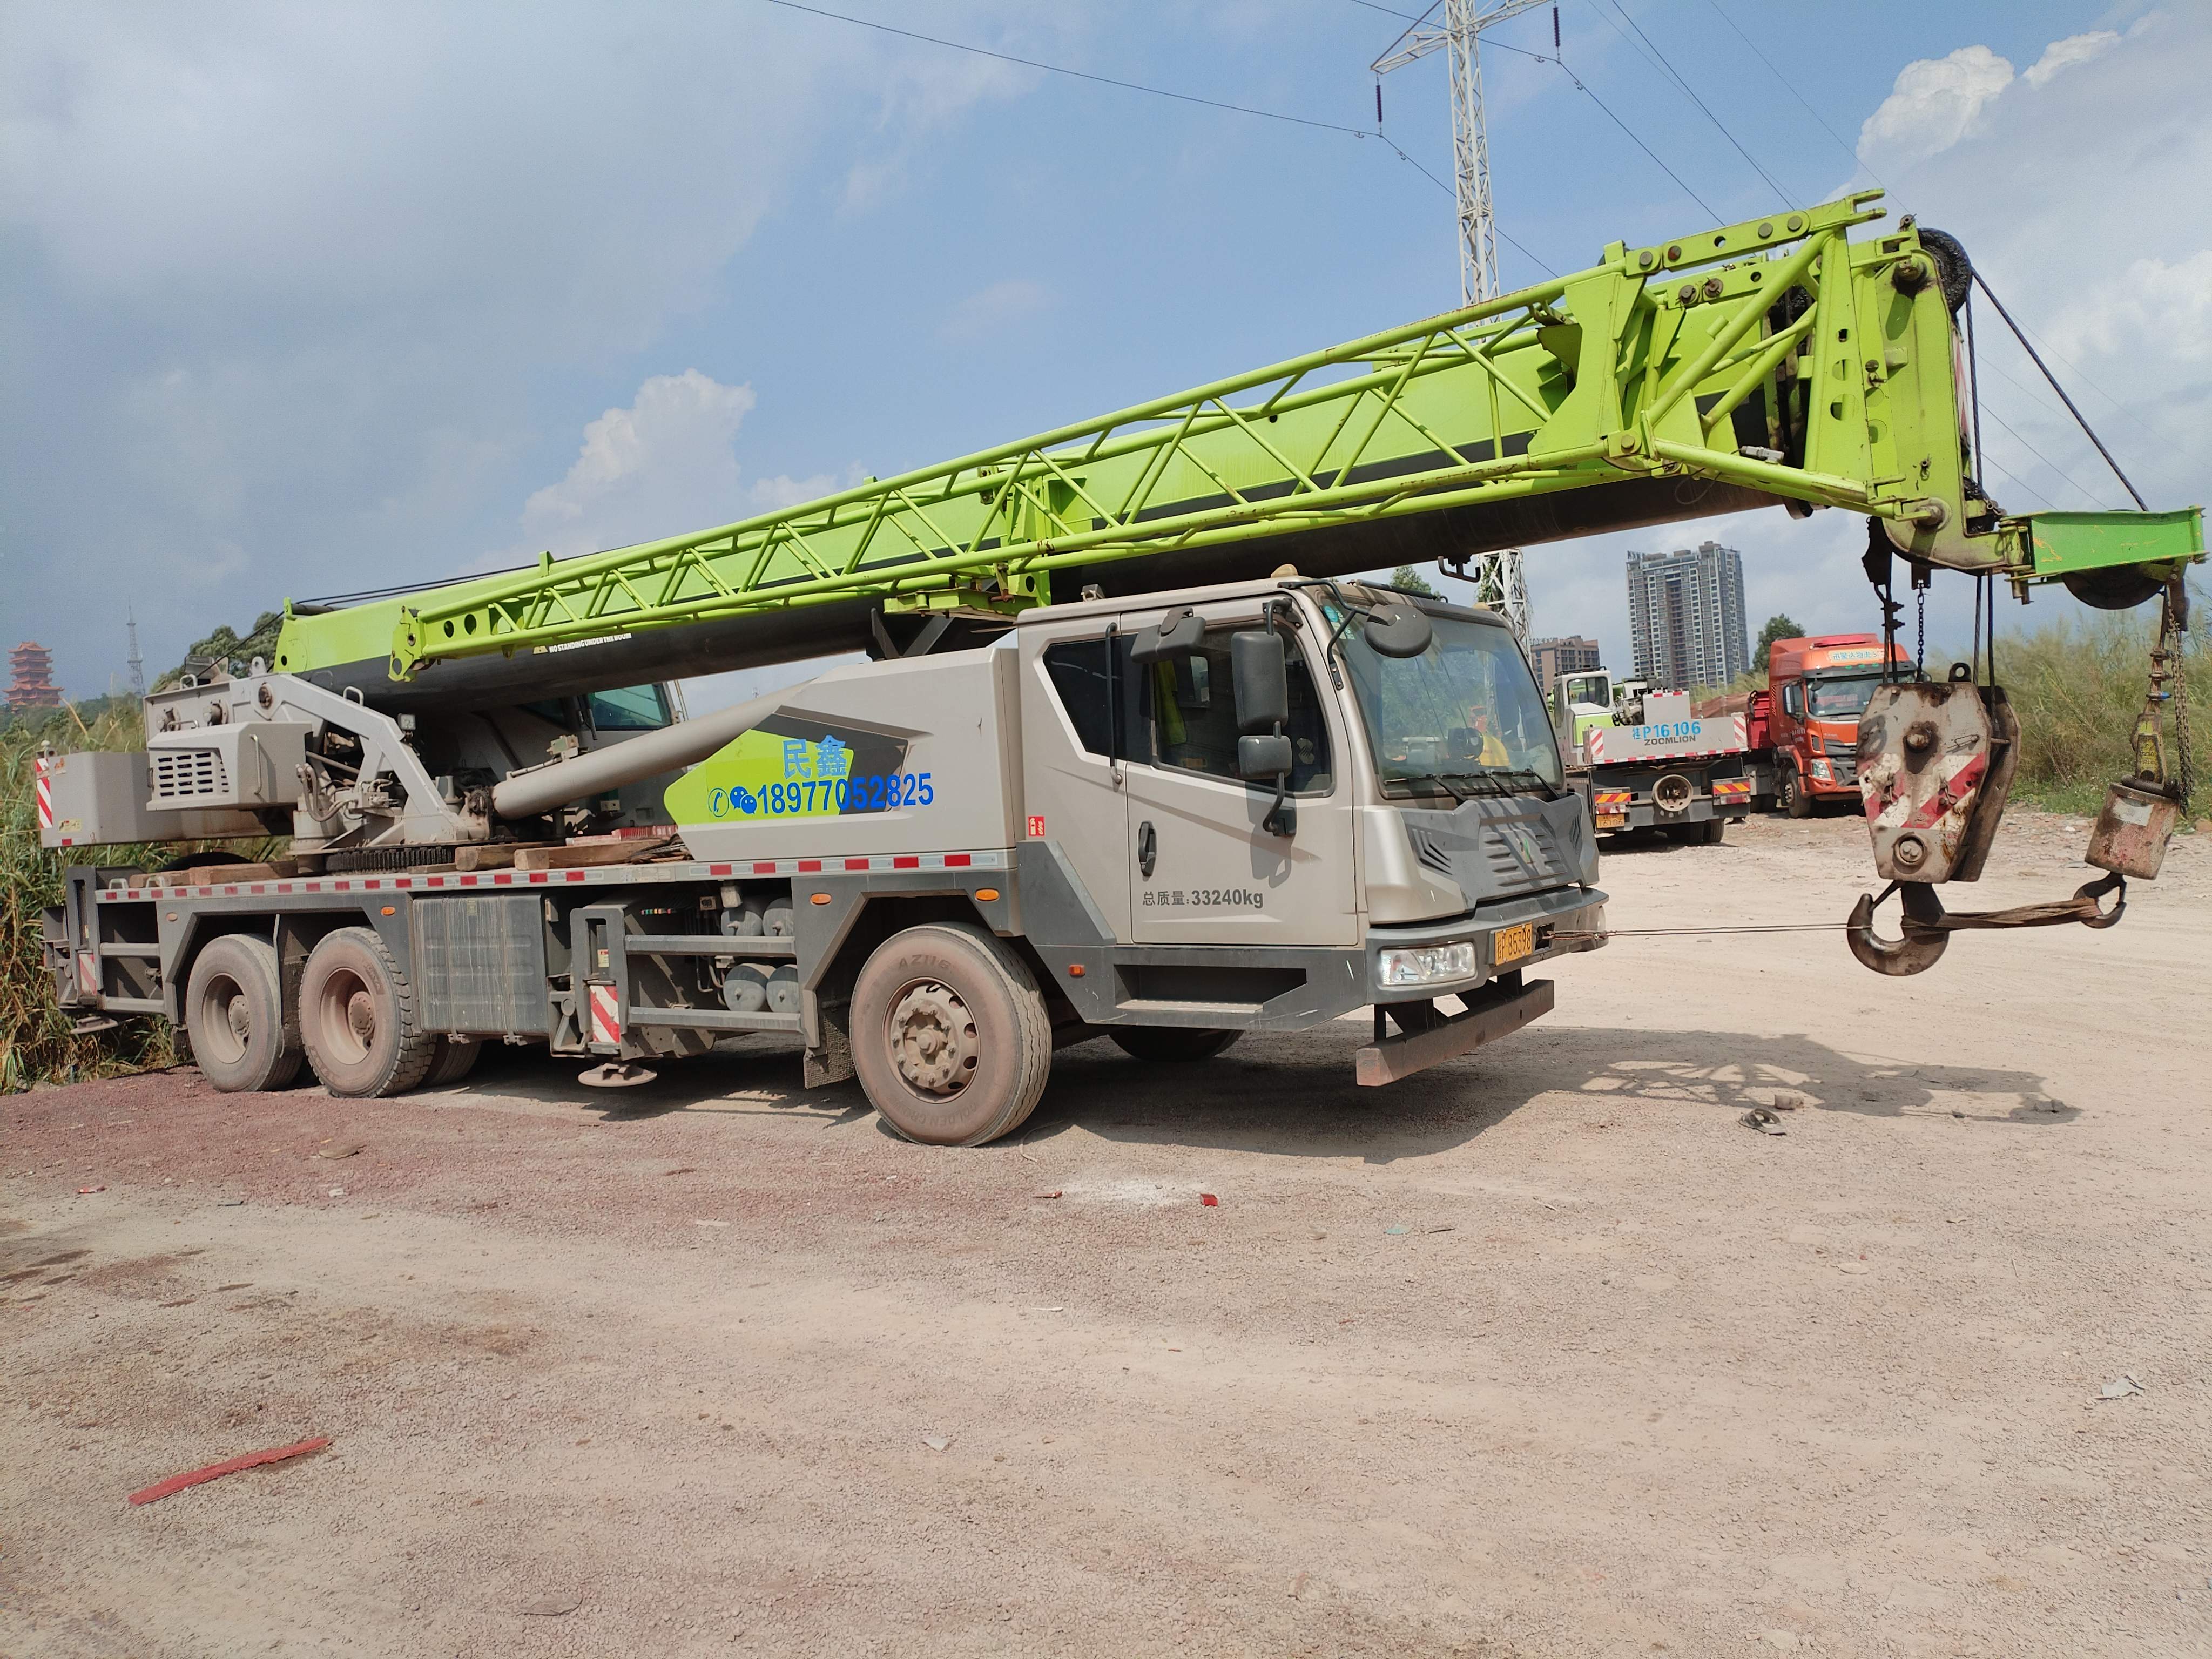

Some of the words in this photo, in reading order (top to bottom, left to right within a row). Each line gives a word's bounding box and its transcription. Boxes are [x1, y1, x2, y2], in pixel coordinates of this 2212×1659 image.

[558, 640, 585, 651] STANDING
[584, 637, 604, 647] UNDER
[1644, 735, 1696, 746] ZOOMLION
[783, 734, 847, 779] 民鑫
[757, 773, 934, 814] 18977052825
